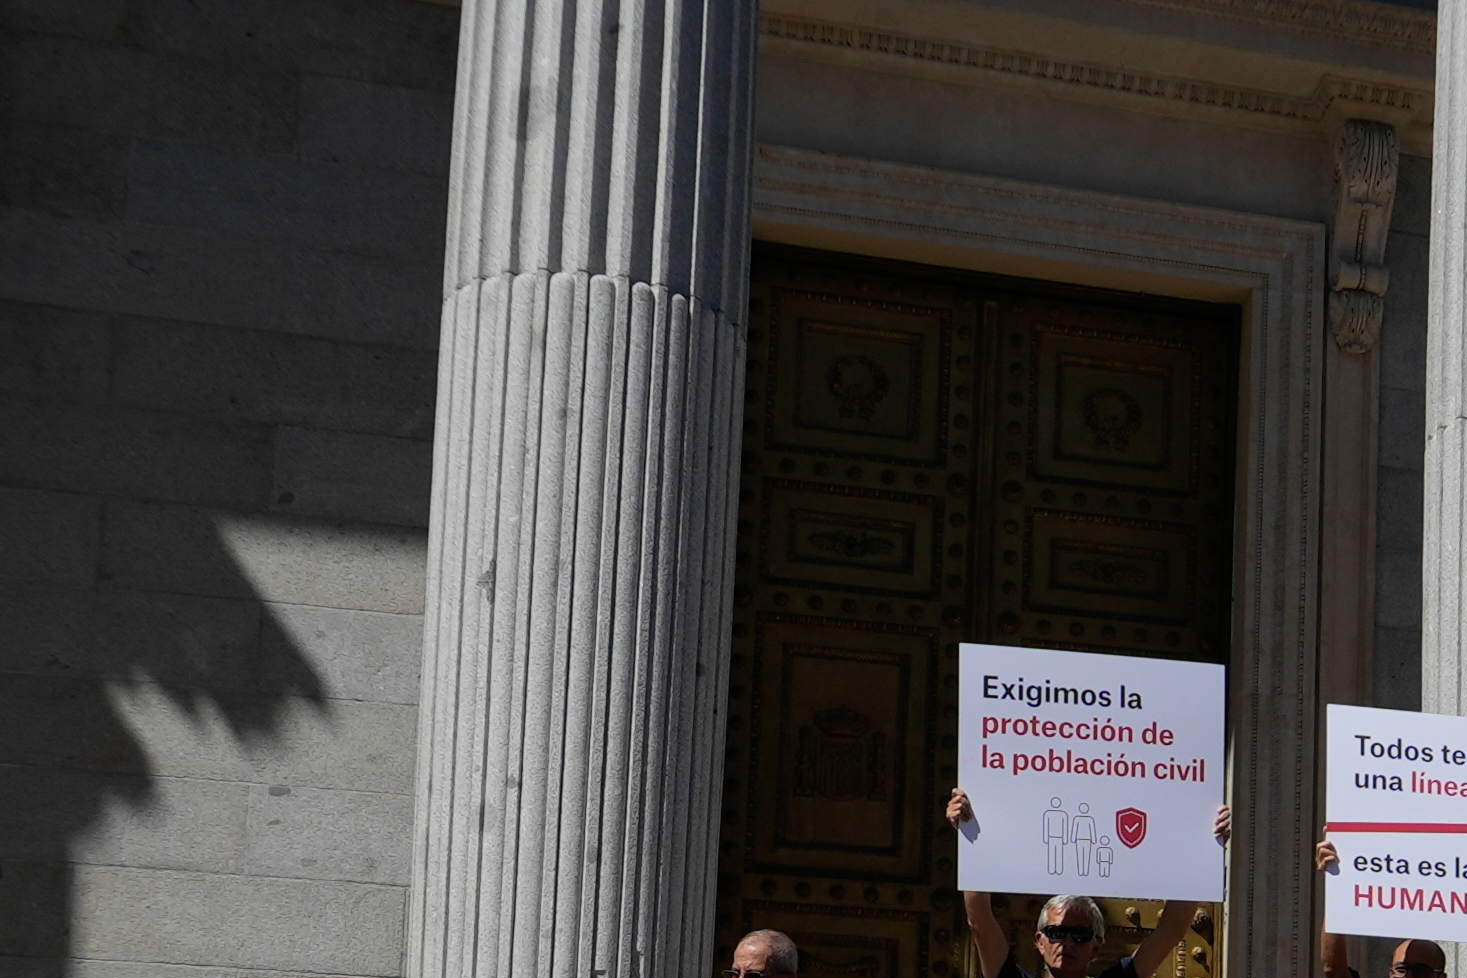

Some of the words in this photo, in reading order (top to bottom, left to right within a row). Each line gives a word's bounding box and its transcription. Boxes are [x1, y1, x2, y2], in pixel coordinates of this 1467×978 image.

[982, 674, 1112, 708] Exigimos
[1119, 684, 1143, 711] la
[981, 714, 1134, 744] protección
[1141, 720, 1175, 747] de
[981, 743, 1006, 770] la
[1012, 748, 1147, 779] población
[1152, 756, 1206, 783] civil
[1354, 734, 1434, 763] Todos
[1354, 772, 1404, 792] una
[1353, 853, 1411, 875] esta
[1417, 860, 1447, 878] es
